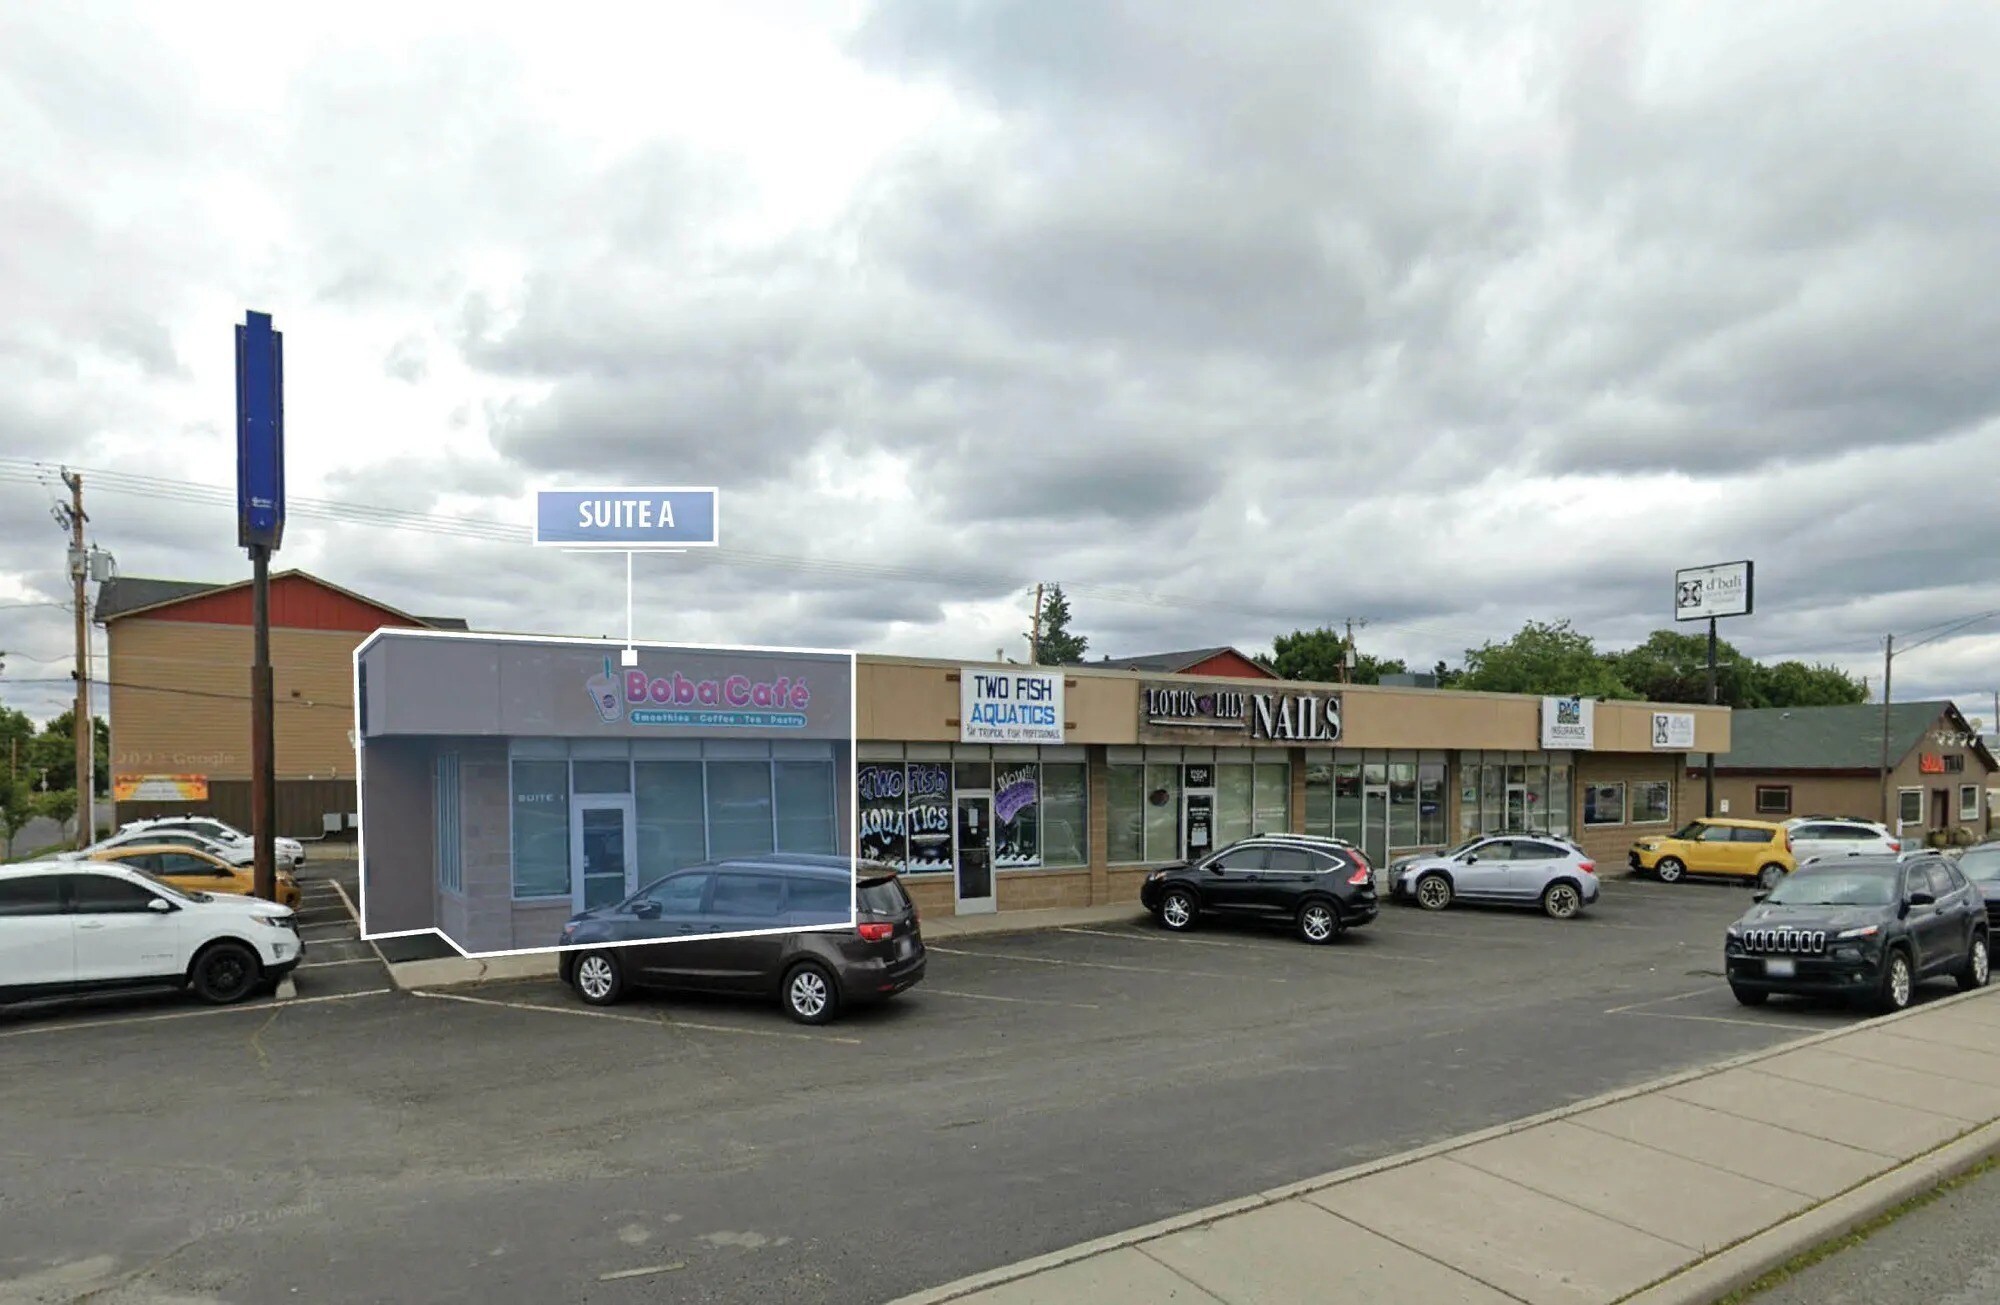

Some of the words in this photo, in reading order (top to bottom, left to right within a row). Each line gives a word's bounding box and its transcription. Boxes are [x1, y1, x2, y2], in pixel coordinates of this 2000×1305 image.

[625, 669, 720, 706] Boba
[725, 672, 810, 711] Café
[974, 675, 1009, 699] TWO
[1016, 677, 1052, 701] FISH
[971, 702, 1055, 727] AQUATICS
[1149, 689, 1197, 716] LOTUS
[1215, 692, 1245, 718] LILY
[1252, 694, 1341, 740] NAILS
[699, 713, 735, 724] Coffee
[859, 804, 948, 845] AQUATICS
